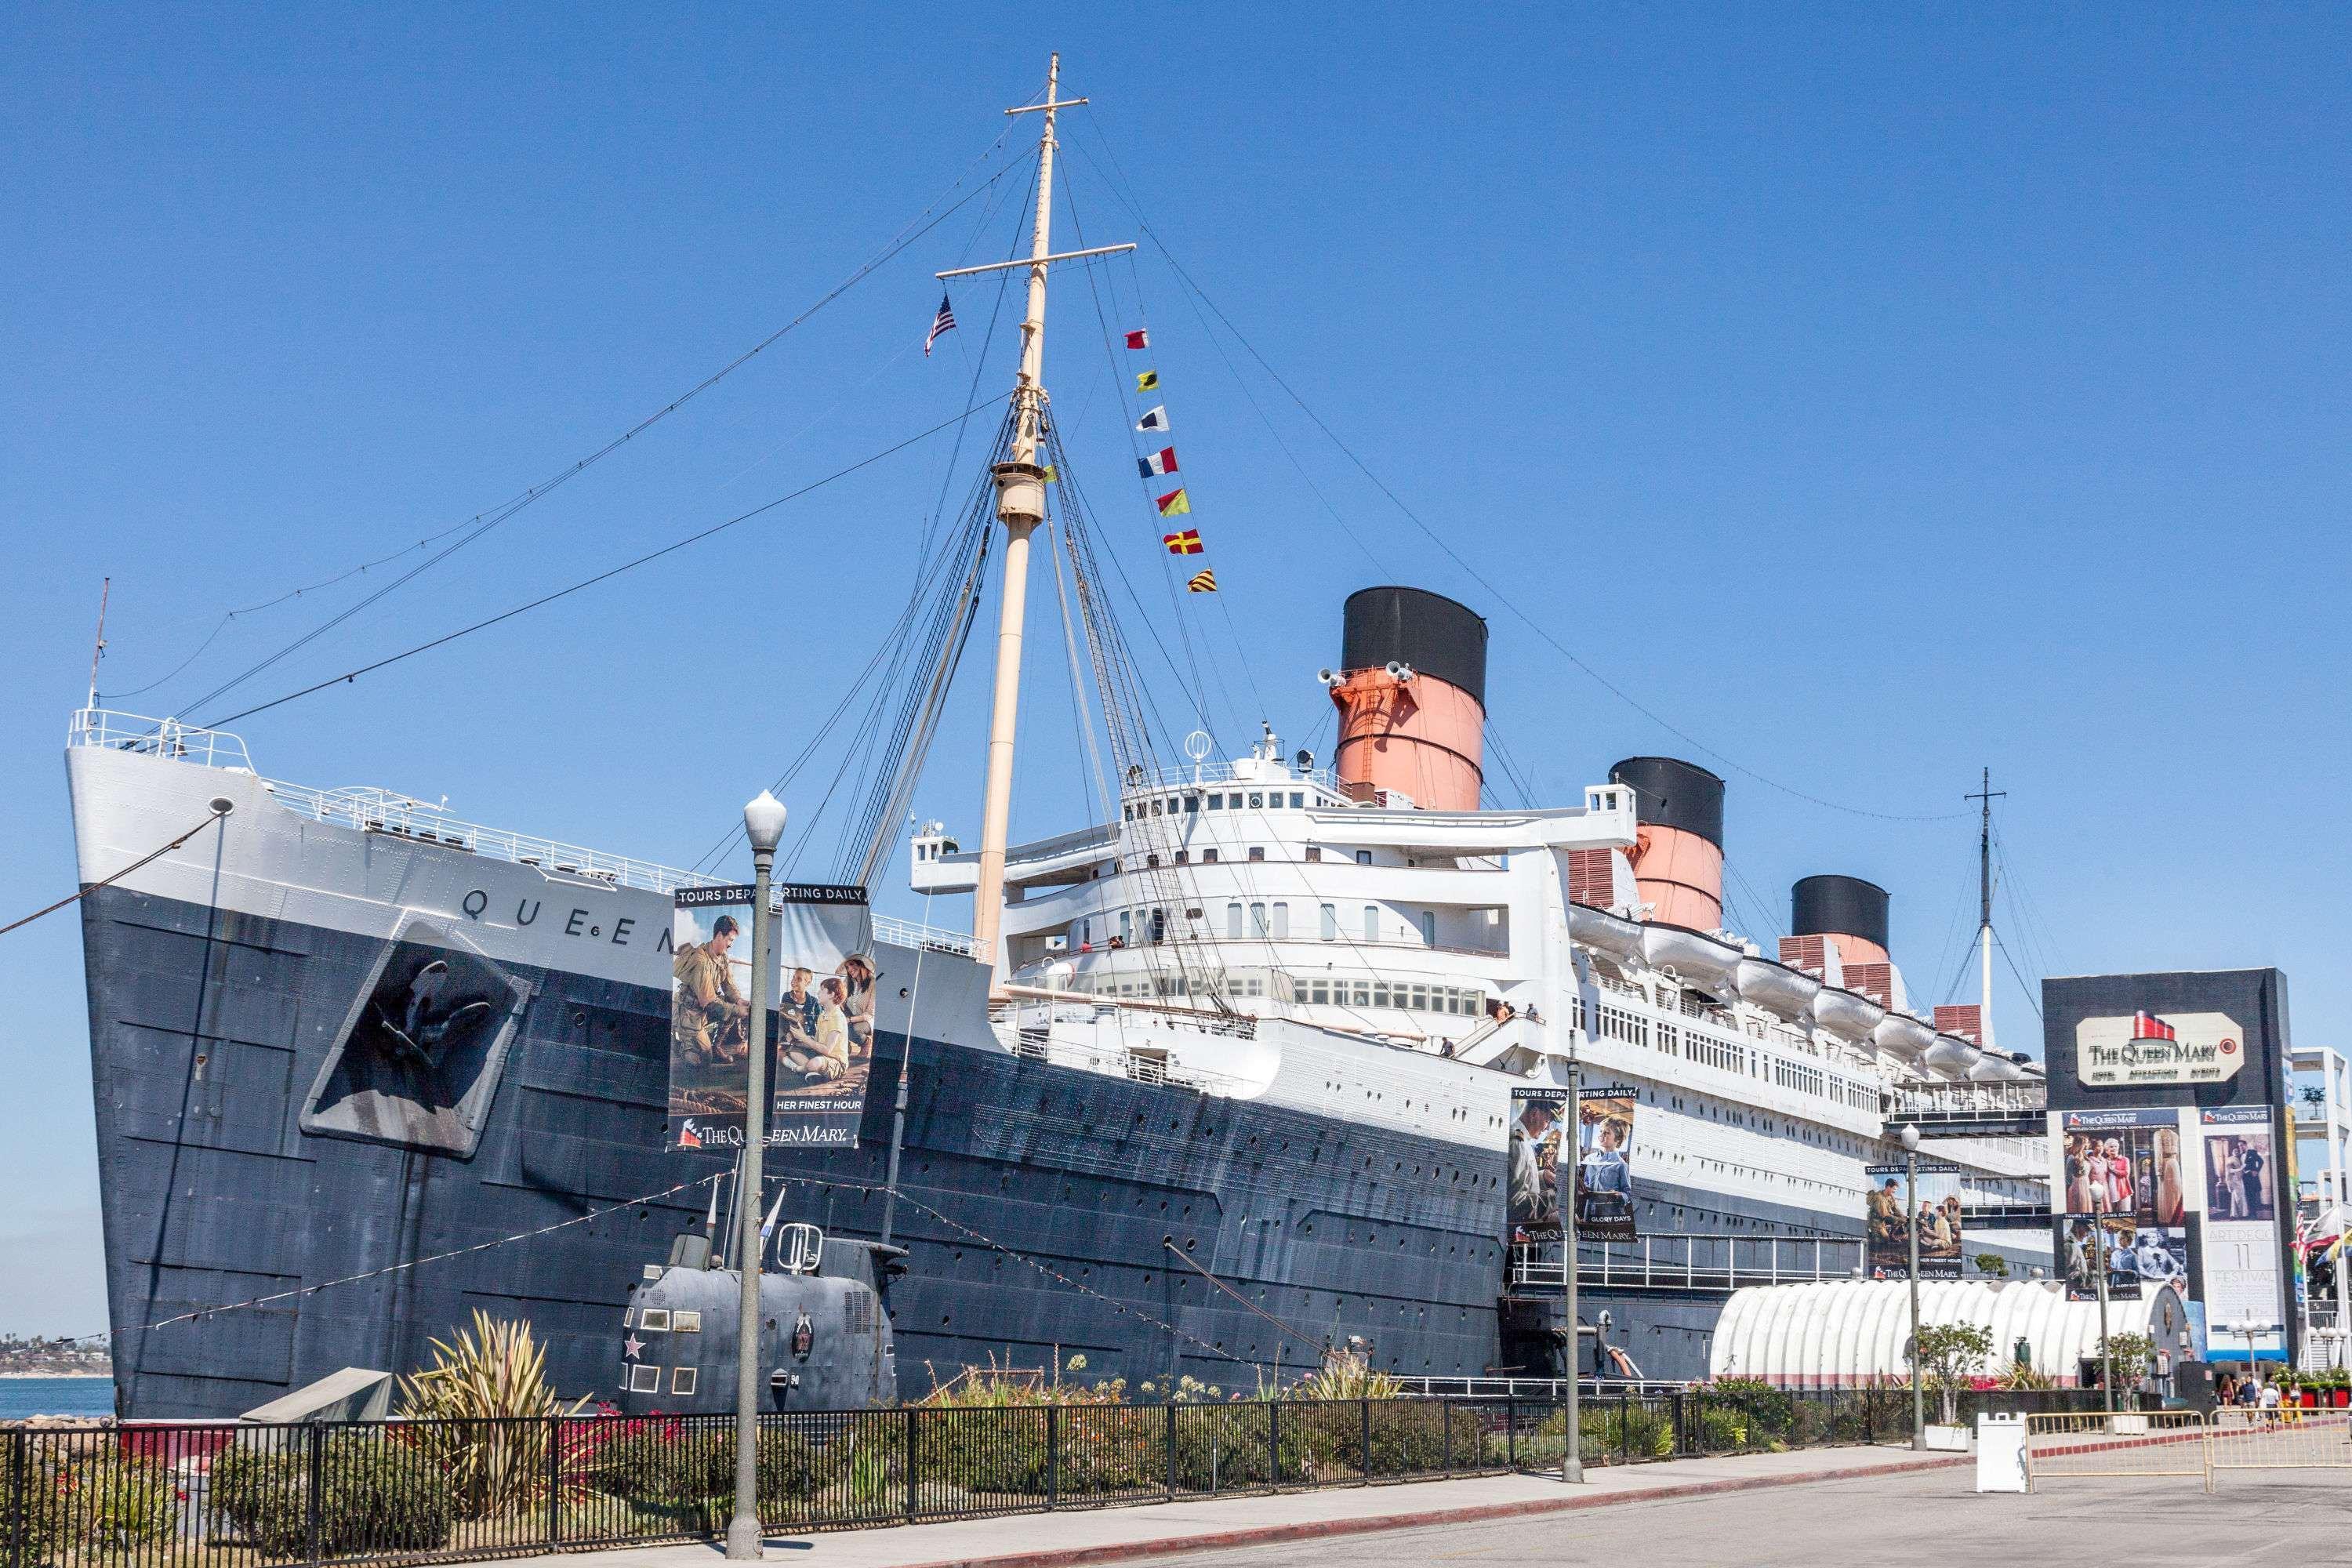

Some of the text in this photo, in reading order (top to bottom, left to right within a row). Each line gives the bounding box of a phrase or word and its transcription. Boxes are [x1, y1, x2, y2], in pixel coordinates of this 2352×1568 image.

[679, 890, 721, 902] TOURS
[826, 888, 861, 899] DAILY
[2089, 1042, 2217, 1062] THE QUEEN MARY
[776, 1101, 862, 1109] HER FINEST HOUR
[2095, 1116, 2117, 1125] QUEEN
[2117, 1115, 2137, 1123] MARY
[702, 1127, 728, 1144] THE
